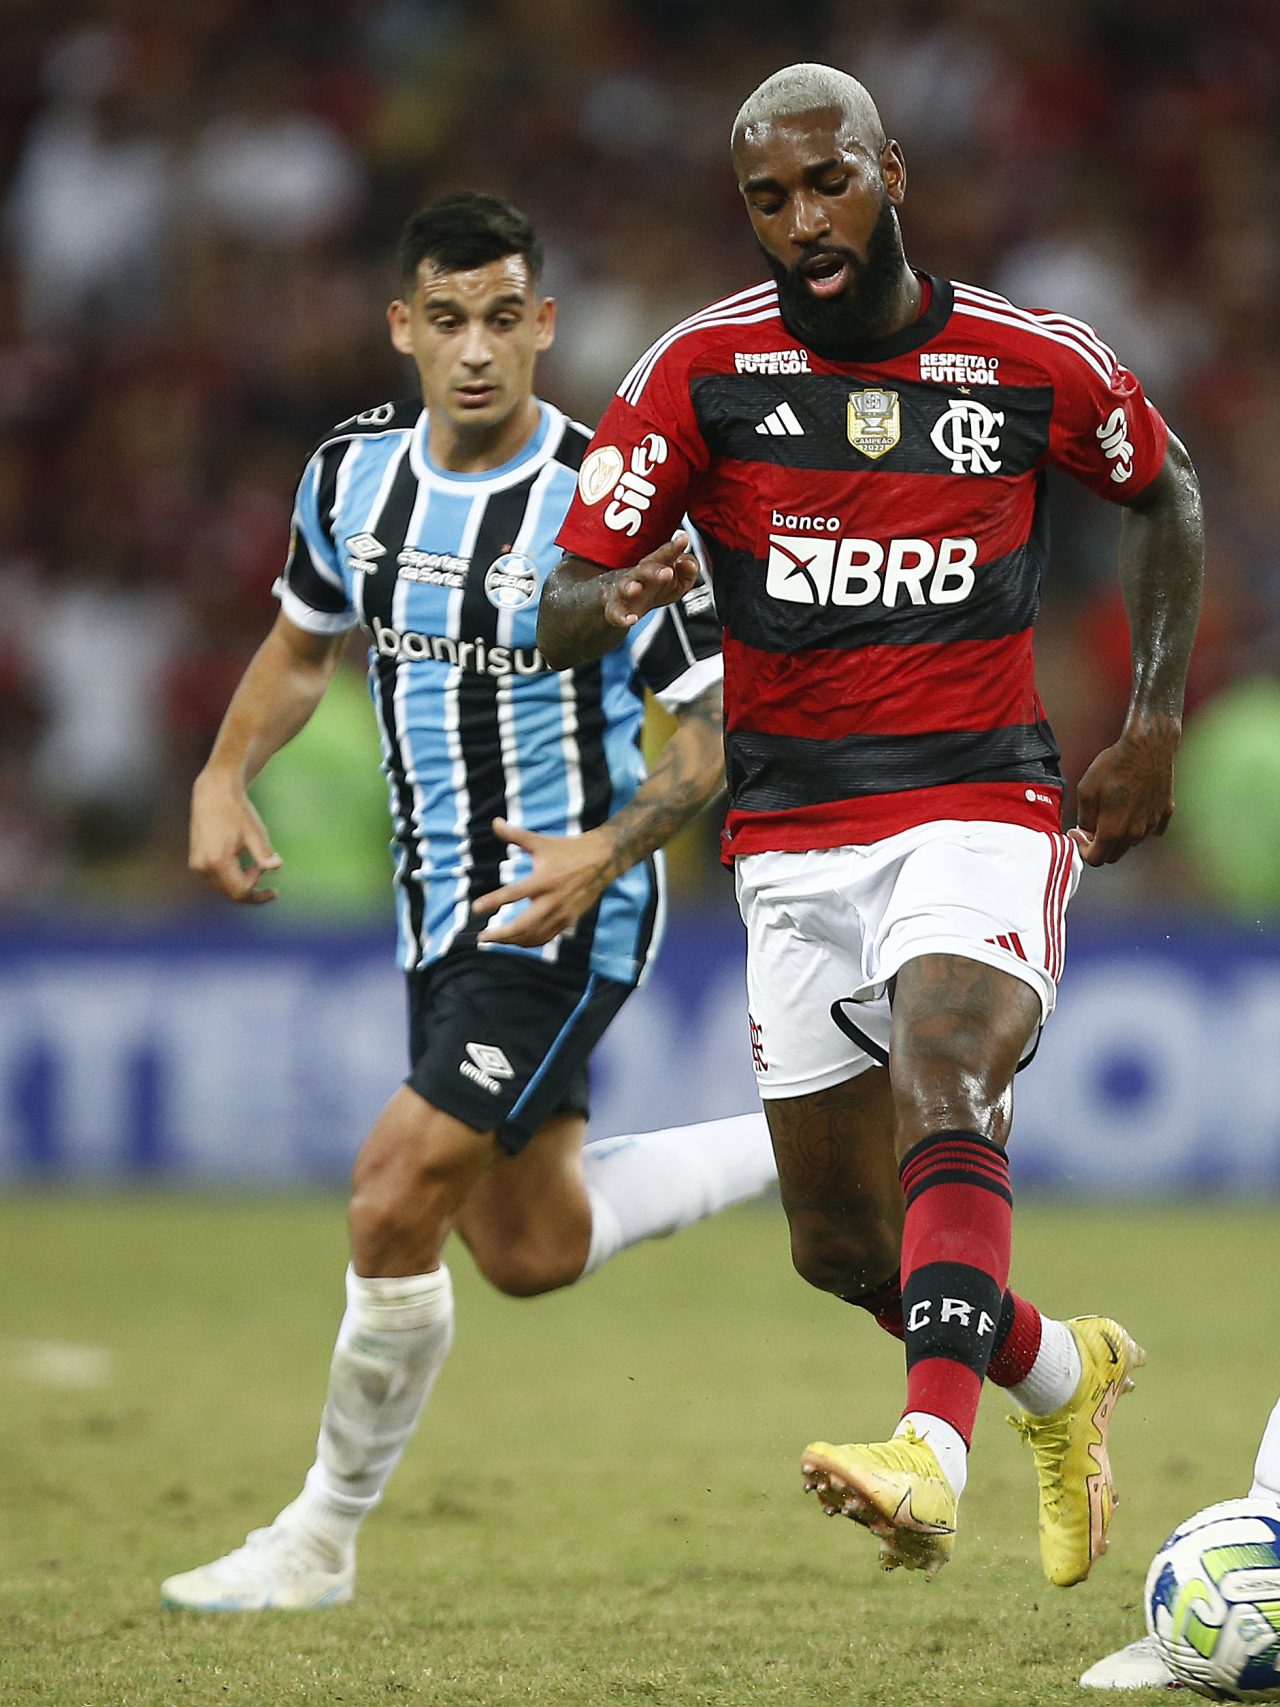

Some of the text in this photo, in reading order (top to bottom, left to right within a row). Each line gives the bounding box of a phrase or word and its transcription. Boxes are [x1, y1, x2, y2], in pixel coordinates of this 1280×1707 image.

[735, 350, 798, 364] RESPEITA
[920, 353, 999, 369] RESPEITA O
[772, 509, 841, 533] banco
[831, 537, 980, 608] BRB
[372, 616, 552, 675] banrisu
